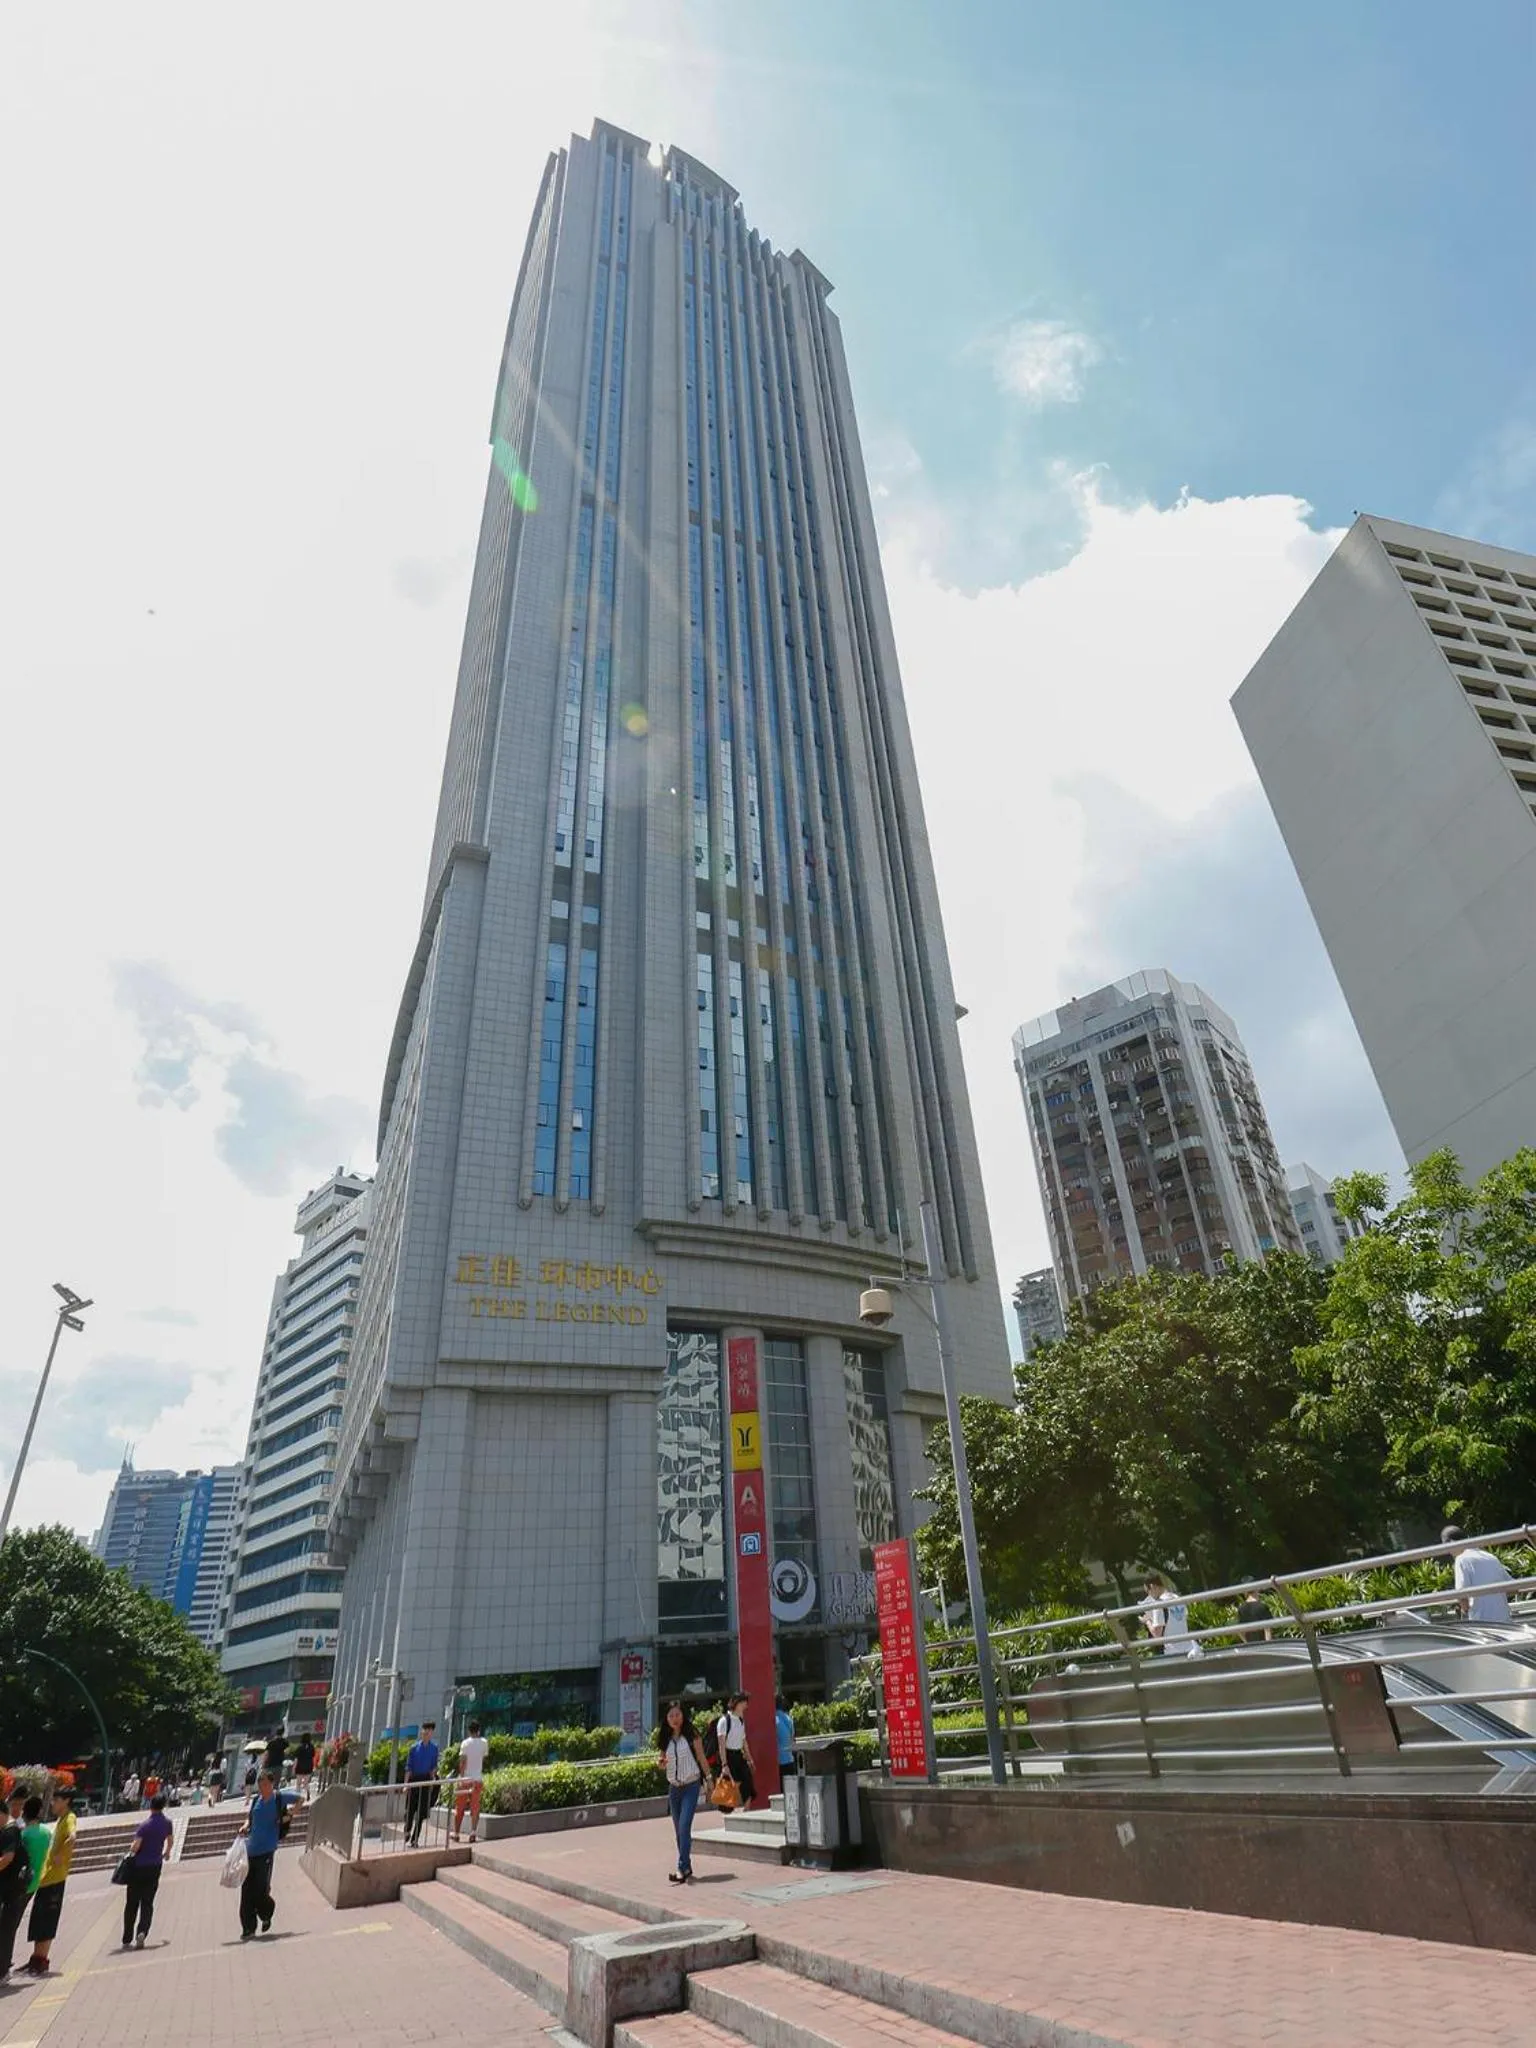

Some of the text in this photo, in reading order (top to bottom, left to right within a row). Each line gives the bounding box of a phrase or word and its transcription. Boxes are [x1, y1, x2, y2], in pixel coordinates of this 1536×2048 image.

[470, 1297, 648, 1326] THE LEGEND
[740, 1485, 757, 1505] A
